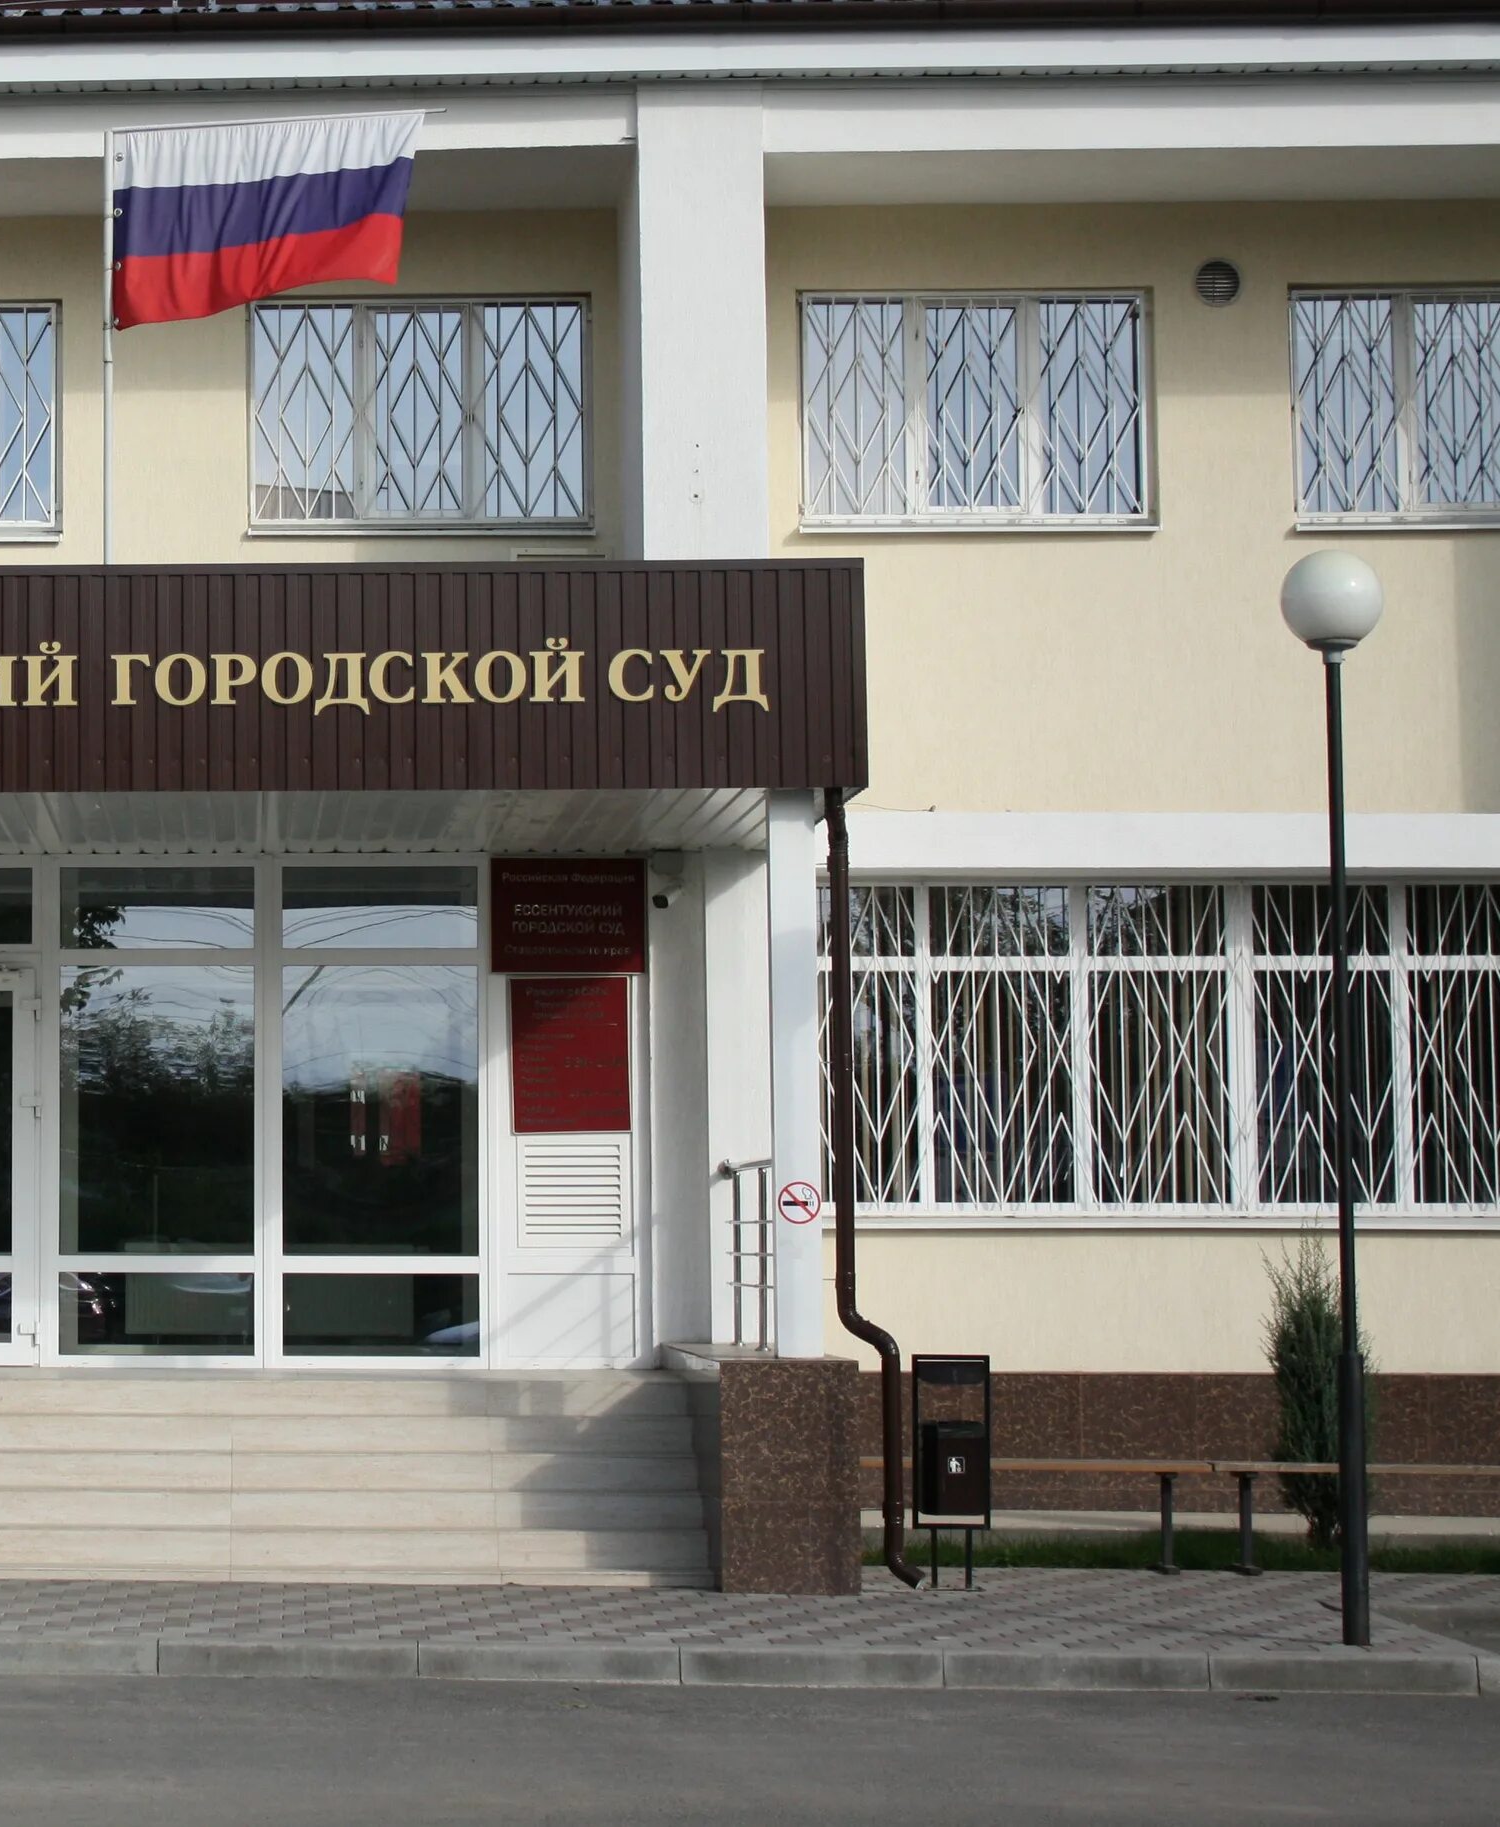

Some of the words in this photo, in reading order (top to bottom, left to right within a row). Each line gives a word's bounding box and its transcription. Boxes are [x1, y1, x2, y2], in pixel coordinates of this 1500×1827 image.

[110, 638, 586, 716] ГОРОДСКОЙ
[608, 648, 770, 713] СУД
[514, 902, 622, 917] ЕССЕНТУКСКИЙ
[512, 920, 595, 935] ГОРОДСКОЙ
[599, 922, 625, 936] СУД
